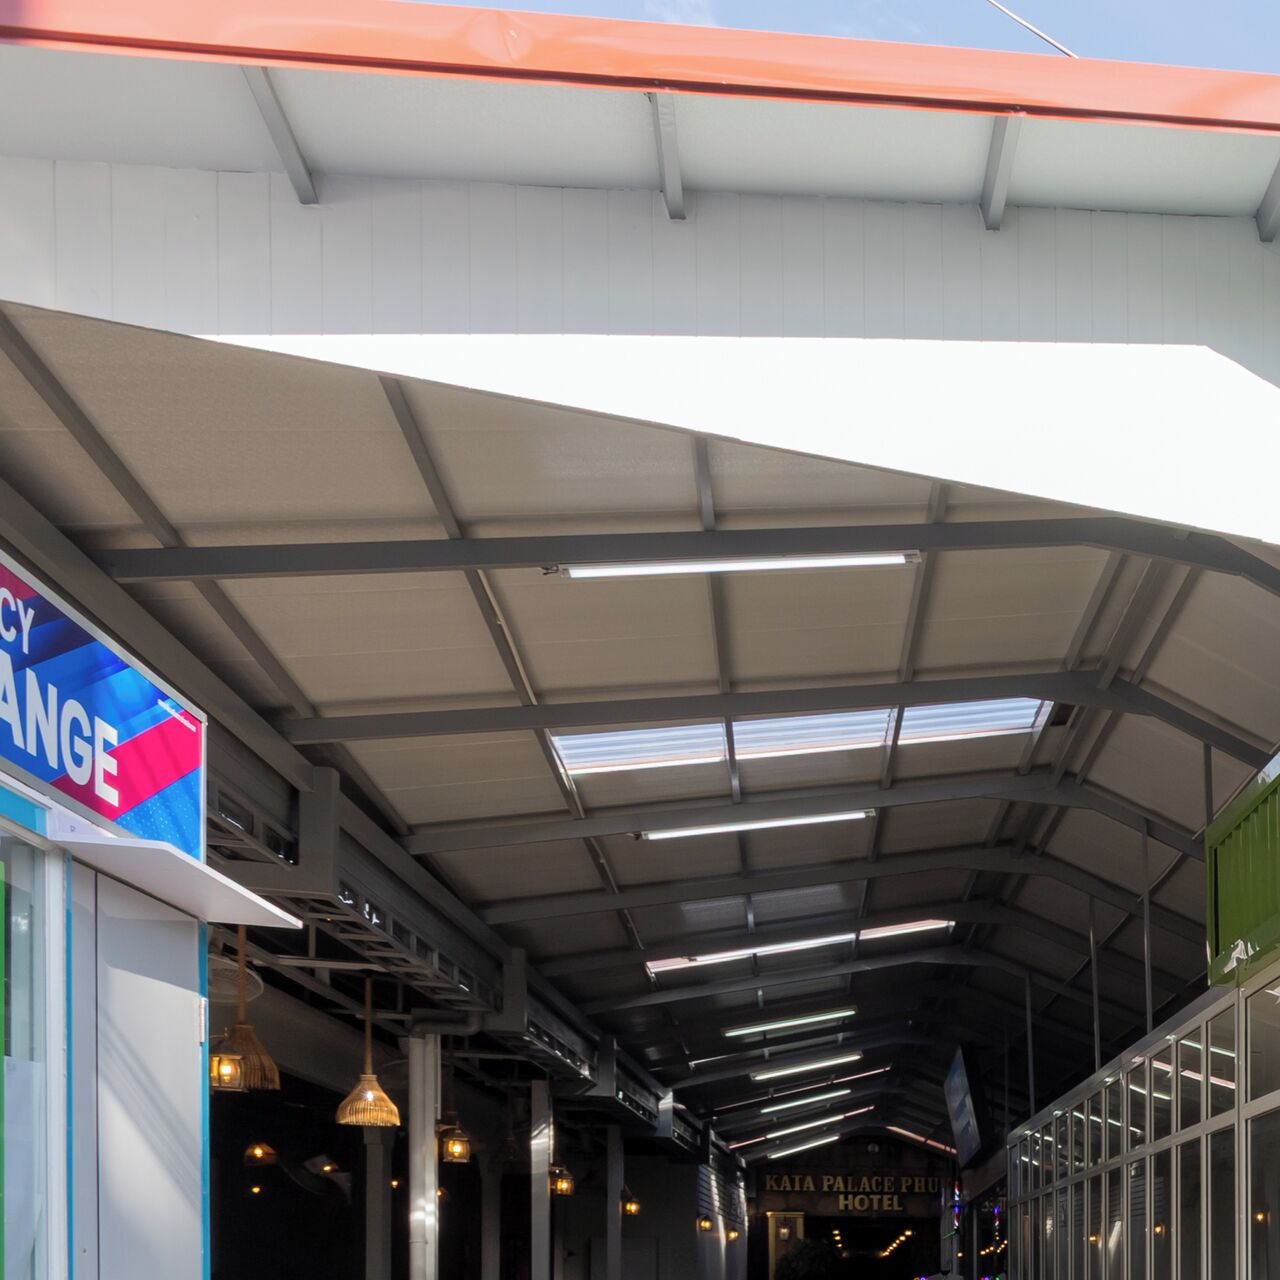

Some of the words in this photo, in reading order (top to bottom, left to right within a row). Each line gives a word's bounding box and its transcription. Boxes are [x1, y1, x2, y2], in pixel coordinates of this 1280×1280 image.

[765, 1174, 816, 1192] KATA
[822, 1174, 895, 1193] PALACE
[901, 1175, 946, 1193] PHU
[838, 1193, 903, 1212] HOTEL
